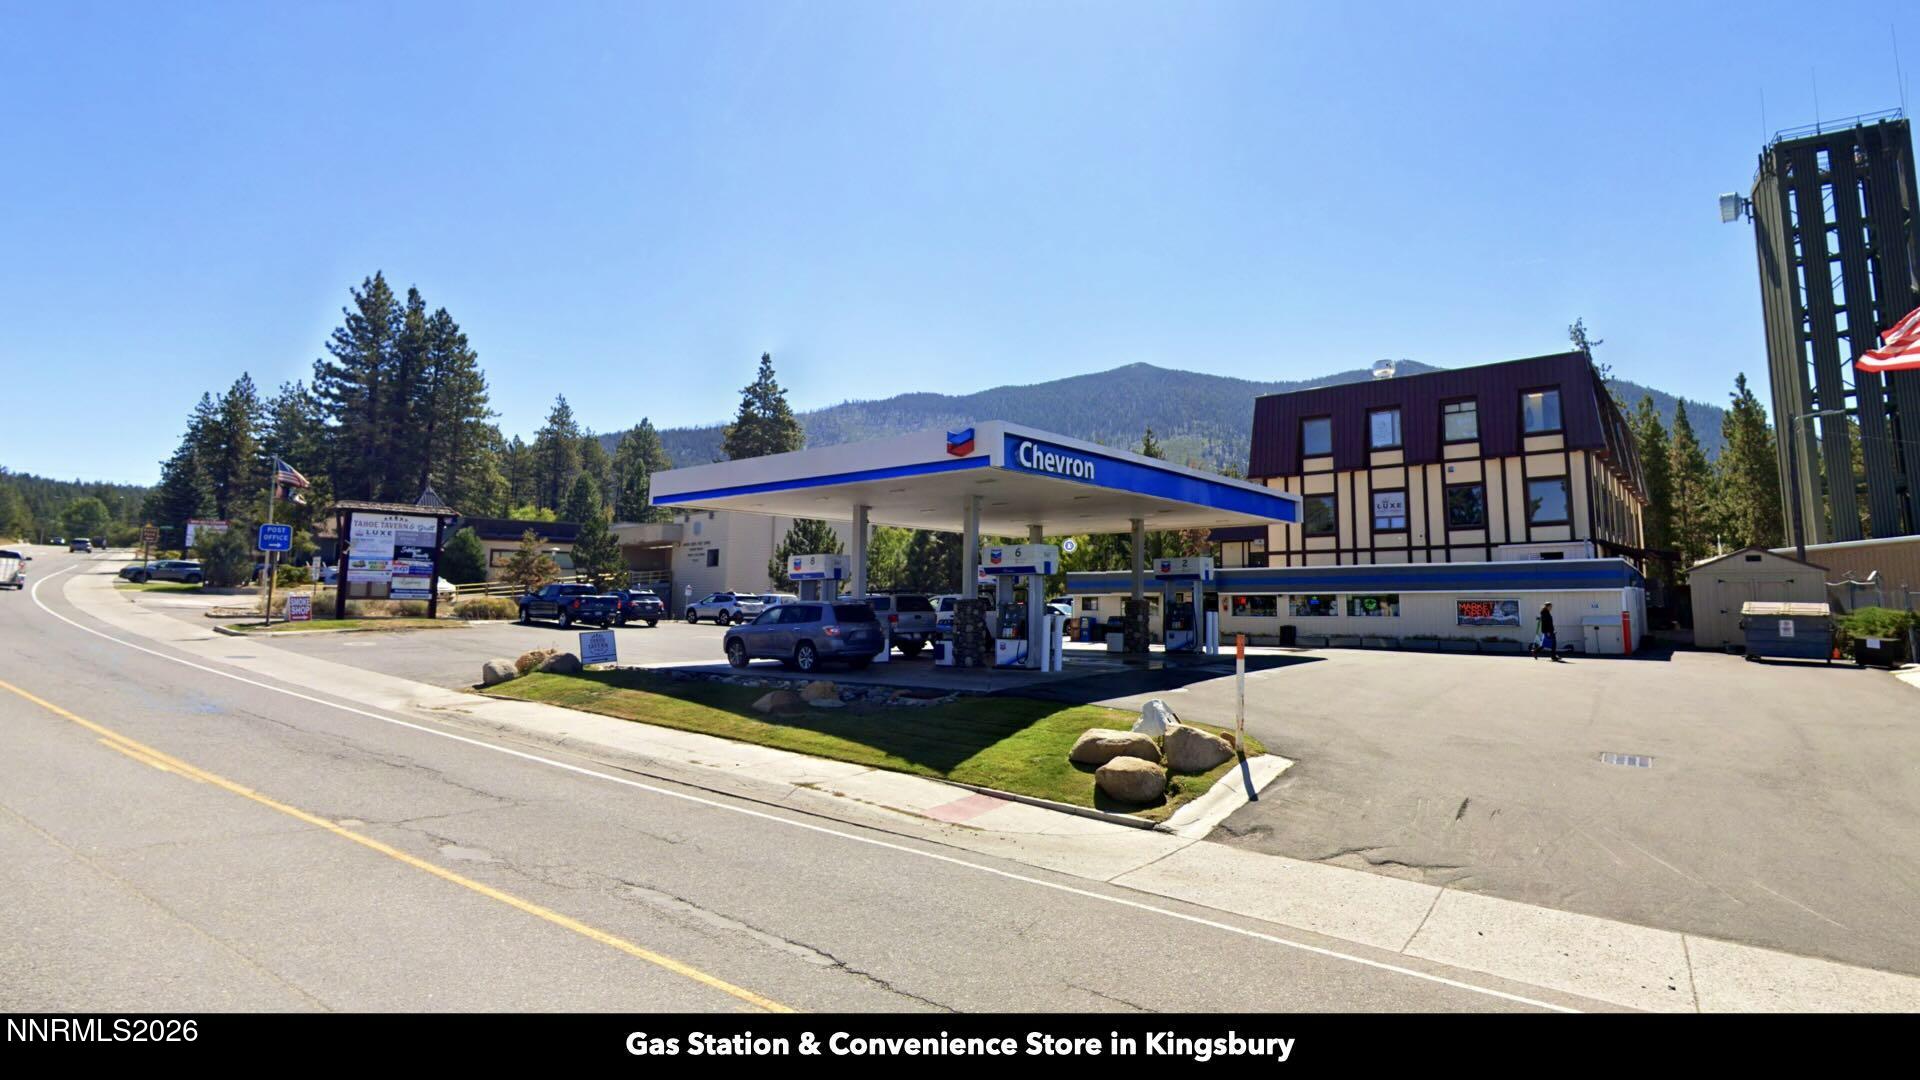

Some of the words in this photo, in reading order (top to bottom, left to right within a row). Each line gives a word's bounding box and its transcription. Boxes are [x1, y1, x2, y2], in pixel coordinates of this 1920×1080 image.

[1019, 440, 1095, 480] Chevron
[353, 519, 380, 528] TAHOE
[380, 521, 408, 529] TAVERN
[1015, 547, 1022, 558] 6
[1182, 559, 1188, 568] 2
[290, 597, 310, 605] SMOKE
[291, 606, 310, 615] SHOP
[1459, 602, 1493, 610] MARKET
[1464, 609, 1491, 617] OPEN
